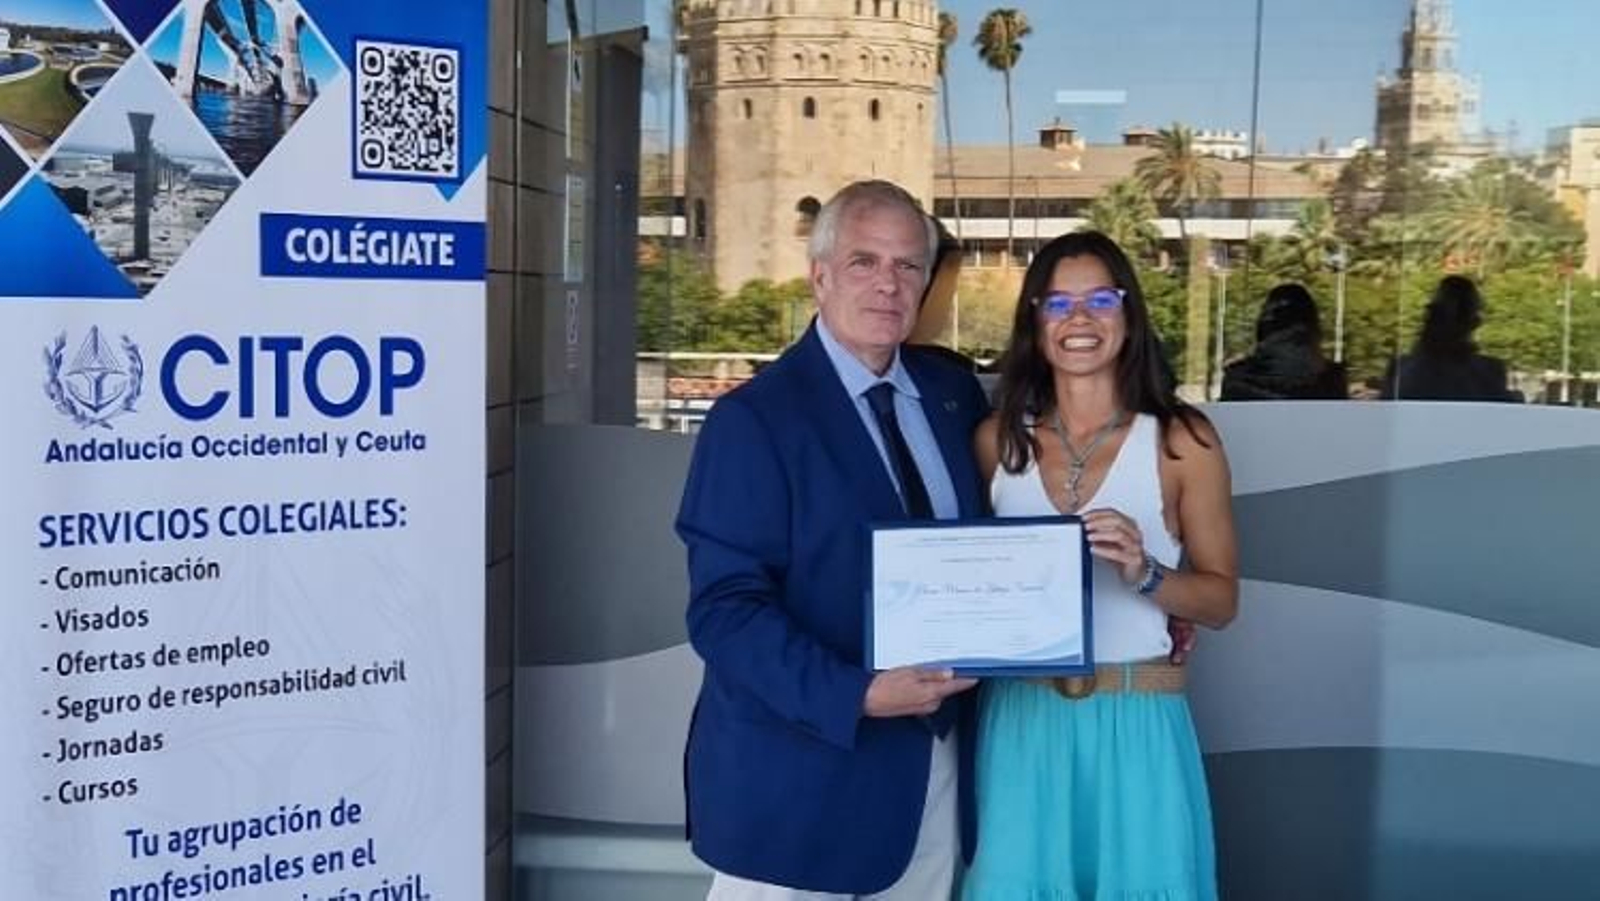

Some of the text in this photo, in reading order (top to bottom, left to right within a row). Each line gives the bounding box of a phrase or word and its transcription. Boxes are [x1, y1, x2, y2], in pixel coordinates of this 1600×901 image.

[285, 223, 455, 267] COLÉGIATE
[159, 334, 426, 421] CITOP
[45, 430, 426, 464] Andalucía Occidental y Ceuta
[38, 498, 407, 548] SERVICIOS COLEGIALES:
[55, 557, 220, 590] Comunicación
[55, 605, 149, 633] Visados
[57, 650, 146, 676] Ofertas
[152, 644, 181, 667] de
[186, 636, 270, 666] empleo
[57, 694, 141, 723] Seguro
[148, 686, 176, 709] de
[182, 665, 356, 708] responsabilidad
[362, 660, 407, 685] civil
[57, 730, 163, 763] Jornadas
[58, 777, 138, 805] Cursos
[125, 797, 362, 858] Tu agrupación de
[312, 851, 344, 875] en
[352, 838, 377, 867] el
